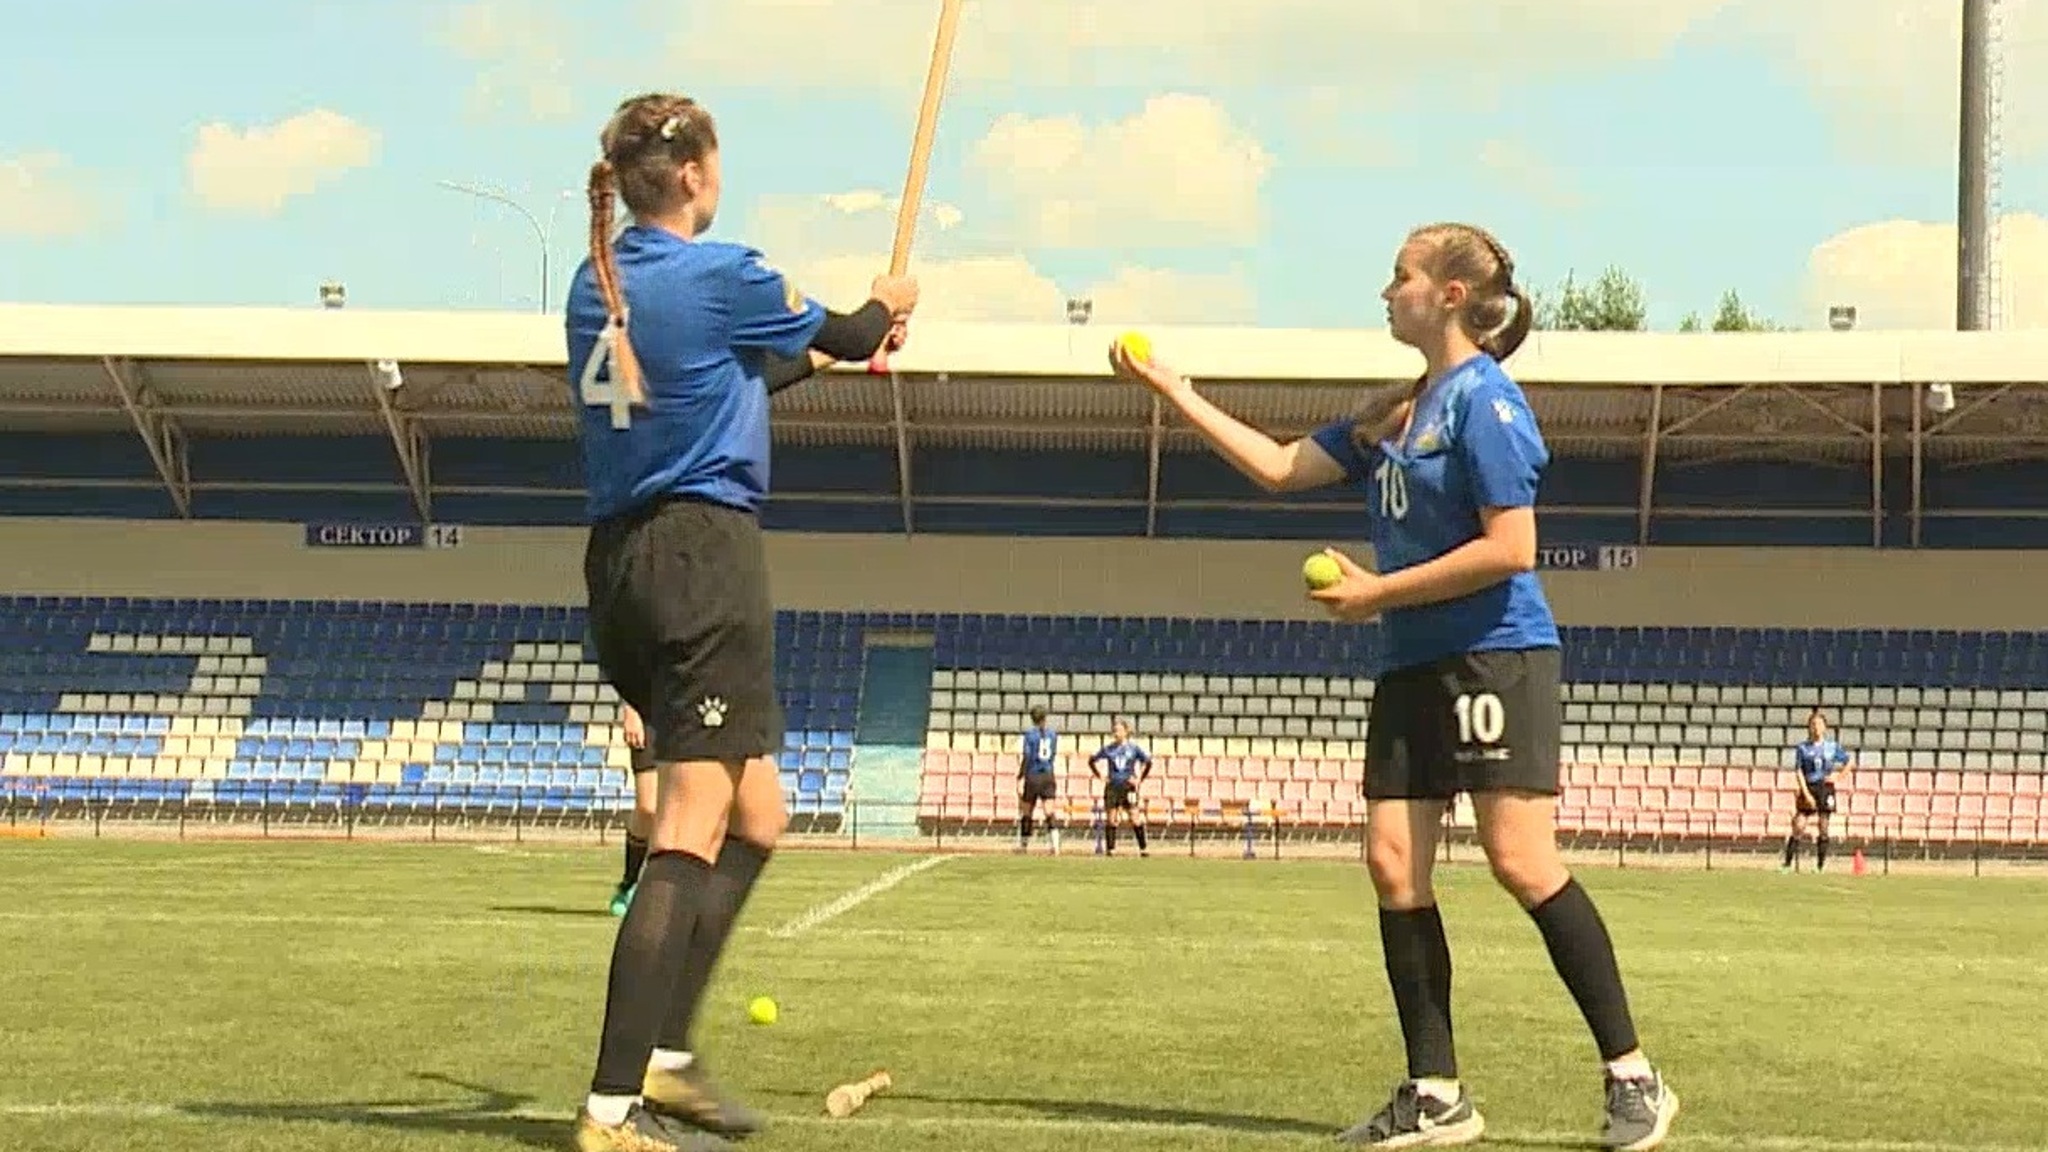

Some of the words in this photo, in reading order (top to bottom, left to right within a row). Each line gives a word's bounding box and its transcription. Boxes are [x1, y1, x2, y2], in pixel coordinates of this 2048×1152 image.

[580, 315, 643, 430] 4
[1375, 457, 1409, 520] 10
[319, 526, 412, 545] СЕКТОР
[433, 526, 459, 546] 14
[1539, 548, 1587, 566] ТОР
[1608, 547, 1634, 567] 15
[1453, 693, 1505, 743] 10
